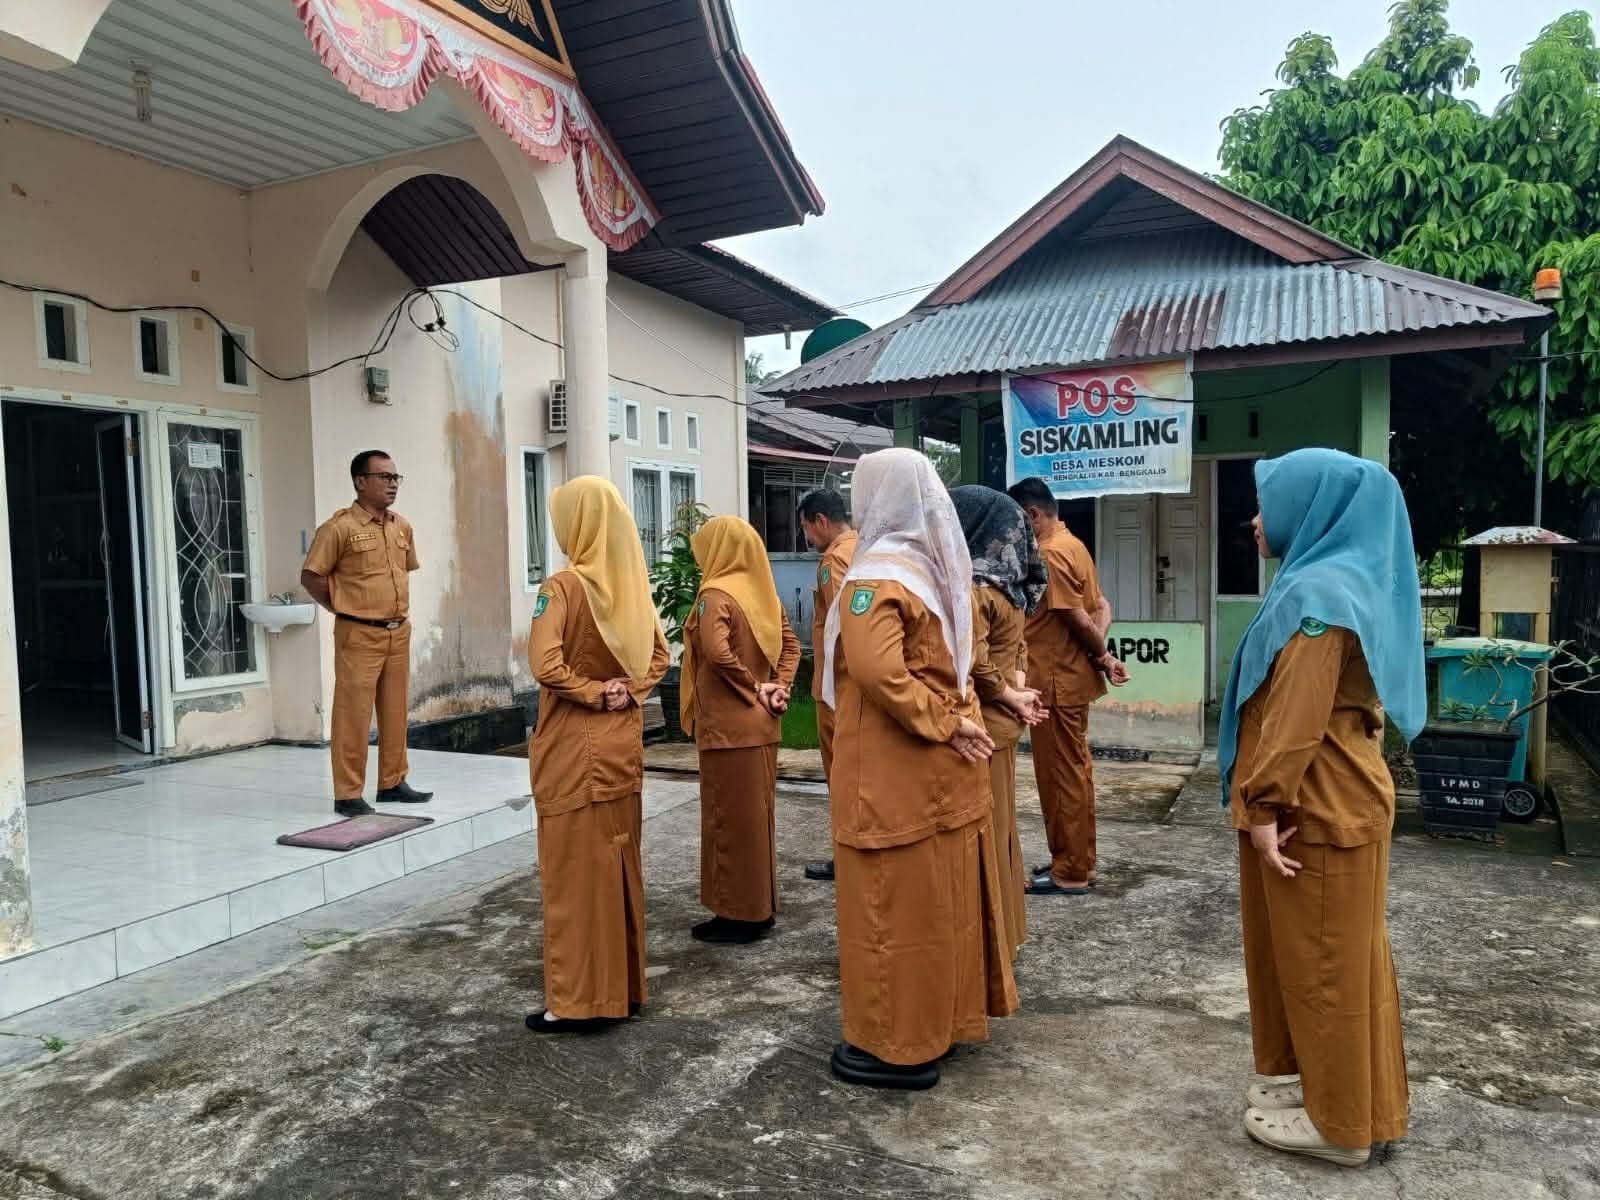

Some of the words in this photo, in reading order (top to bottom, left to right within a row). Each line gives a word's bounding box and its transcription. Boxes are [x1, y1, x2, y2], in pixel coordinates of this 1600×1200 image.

[1057, 376, 1136, 419] POS
[1020, 418, 1178, 456] SISKAMLING
[1053, 460, 1084, 471] DESA
[1088, 455, 1145, 469] MESKOM
[1120, 467, 1167, 477] BENGKALIS
[1107, 637, 1169, 663] APOR
